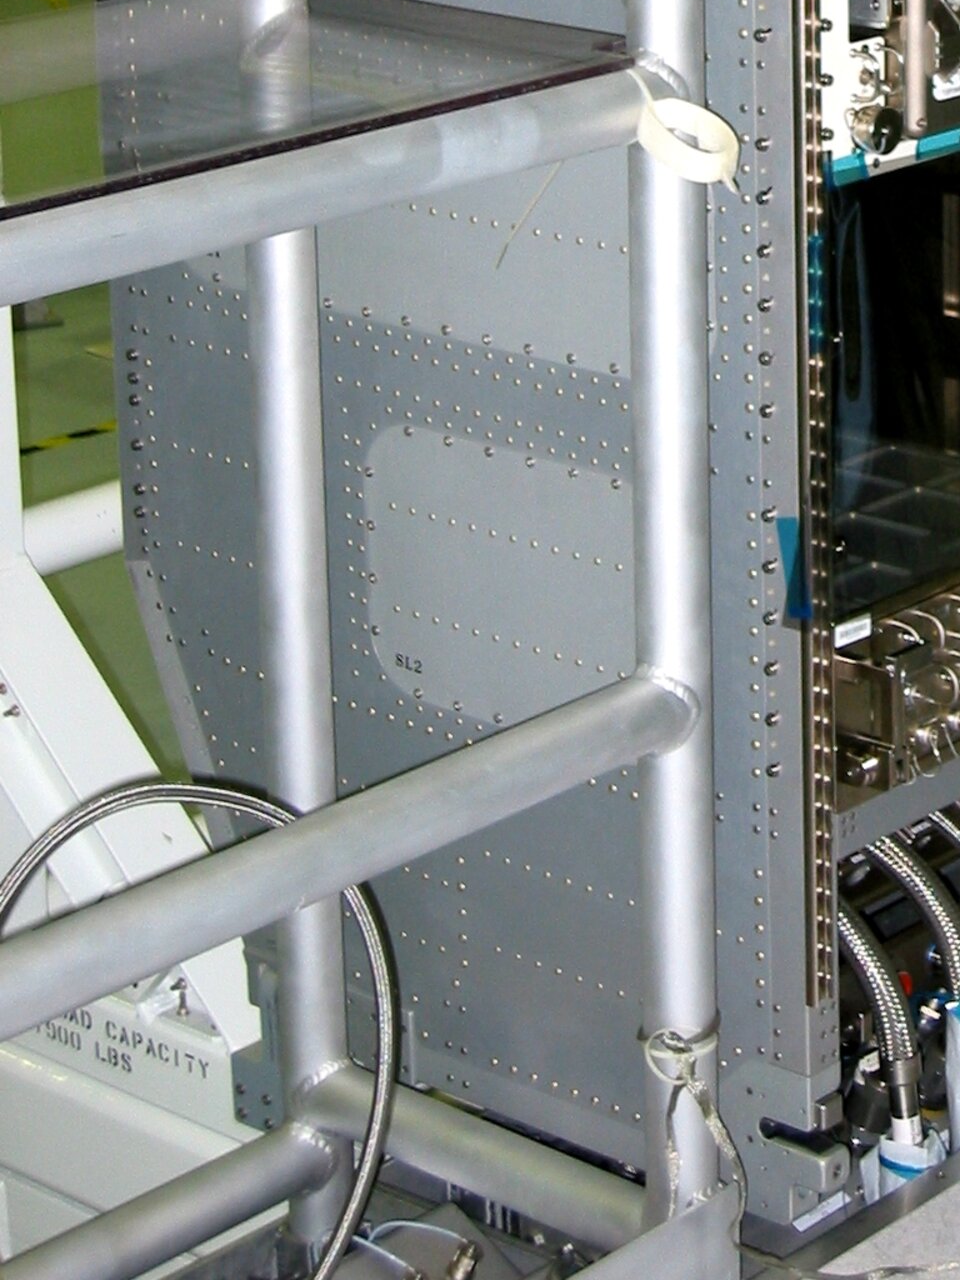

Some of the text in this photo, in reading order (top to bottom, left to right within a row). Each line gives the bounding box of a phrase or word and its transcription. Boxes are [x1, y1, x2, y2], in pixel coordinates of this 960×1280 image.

[395, 652, 424, 674] SL2
[95, 1041, 133, 1073] LBS
[106, 1020, 209, 1079] CAPACITY
